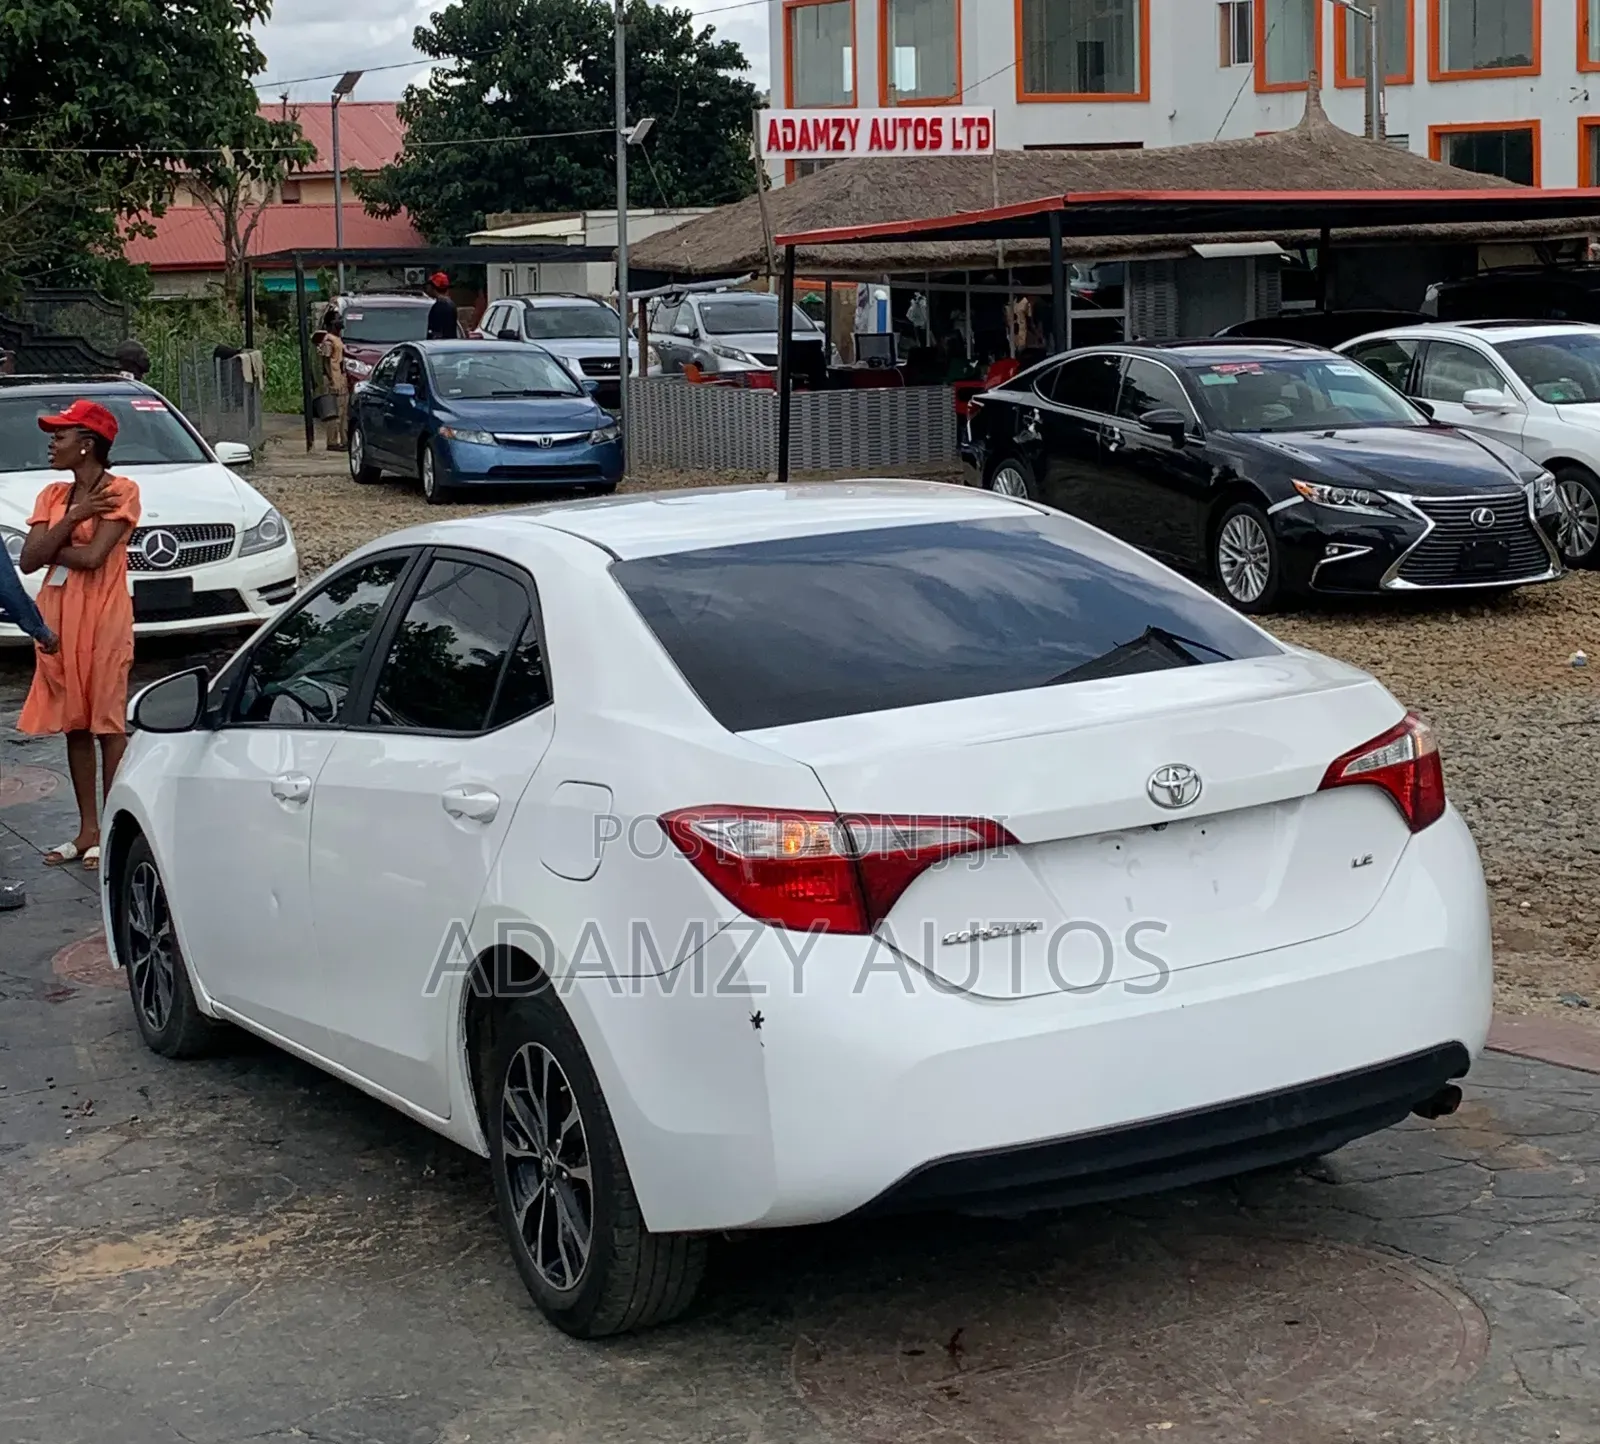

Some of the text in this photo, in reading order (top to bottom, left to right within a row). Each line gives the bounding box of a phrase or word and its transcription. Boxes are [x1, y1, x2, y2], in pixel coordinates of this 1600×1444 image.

[766, 117, 991, 153] ADAMZY AUTOS LTD
